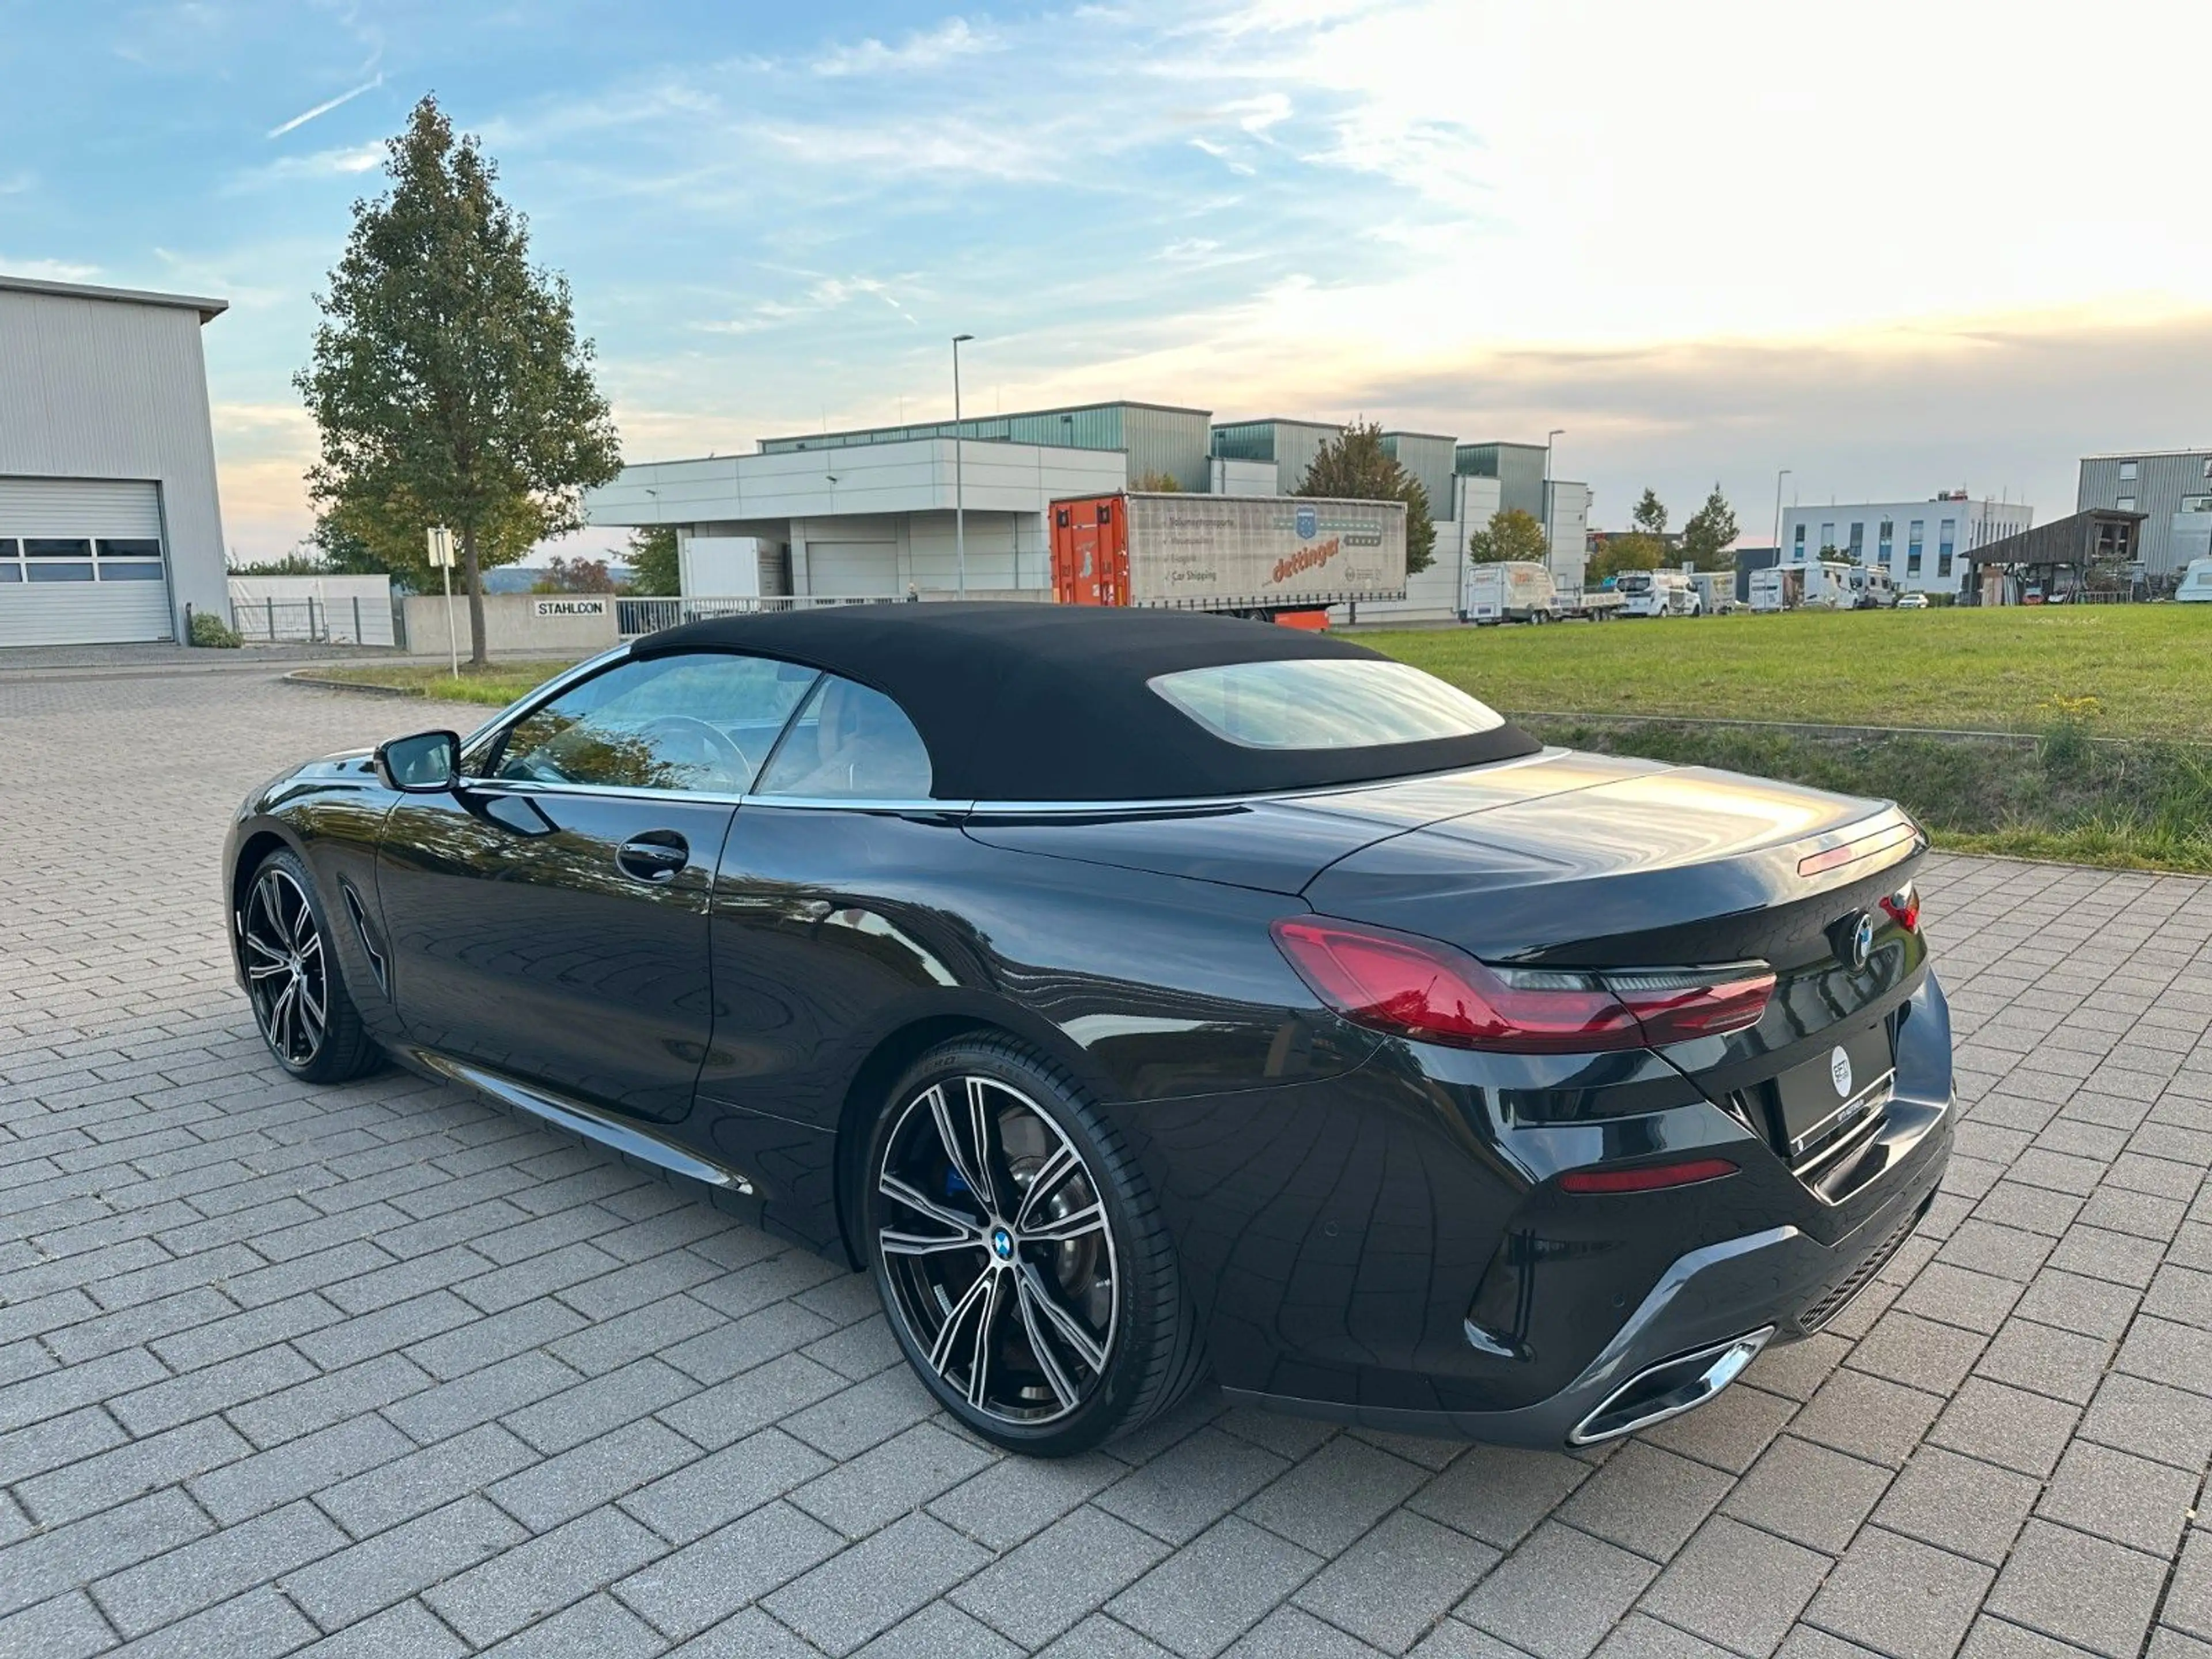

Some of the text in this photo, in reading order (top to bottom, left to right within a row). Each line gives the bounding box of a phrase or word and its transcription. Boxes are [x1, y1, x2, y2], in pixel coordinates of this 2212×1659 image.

[1272, 537, 1339, 582] dettinger
[1187, 570, 1217, 582] Shipping
[539, 603, 603, 615] STAHLCON
